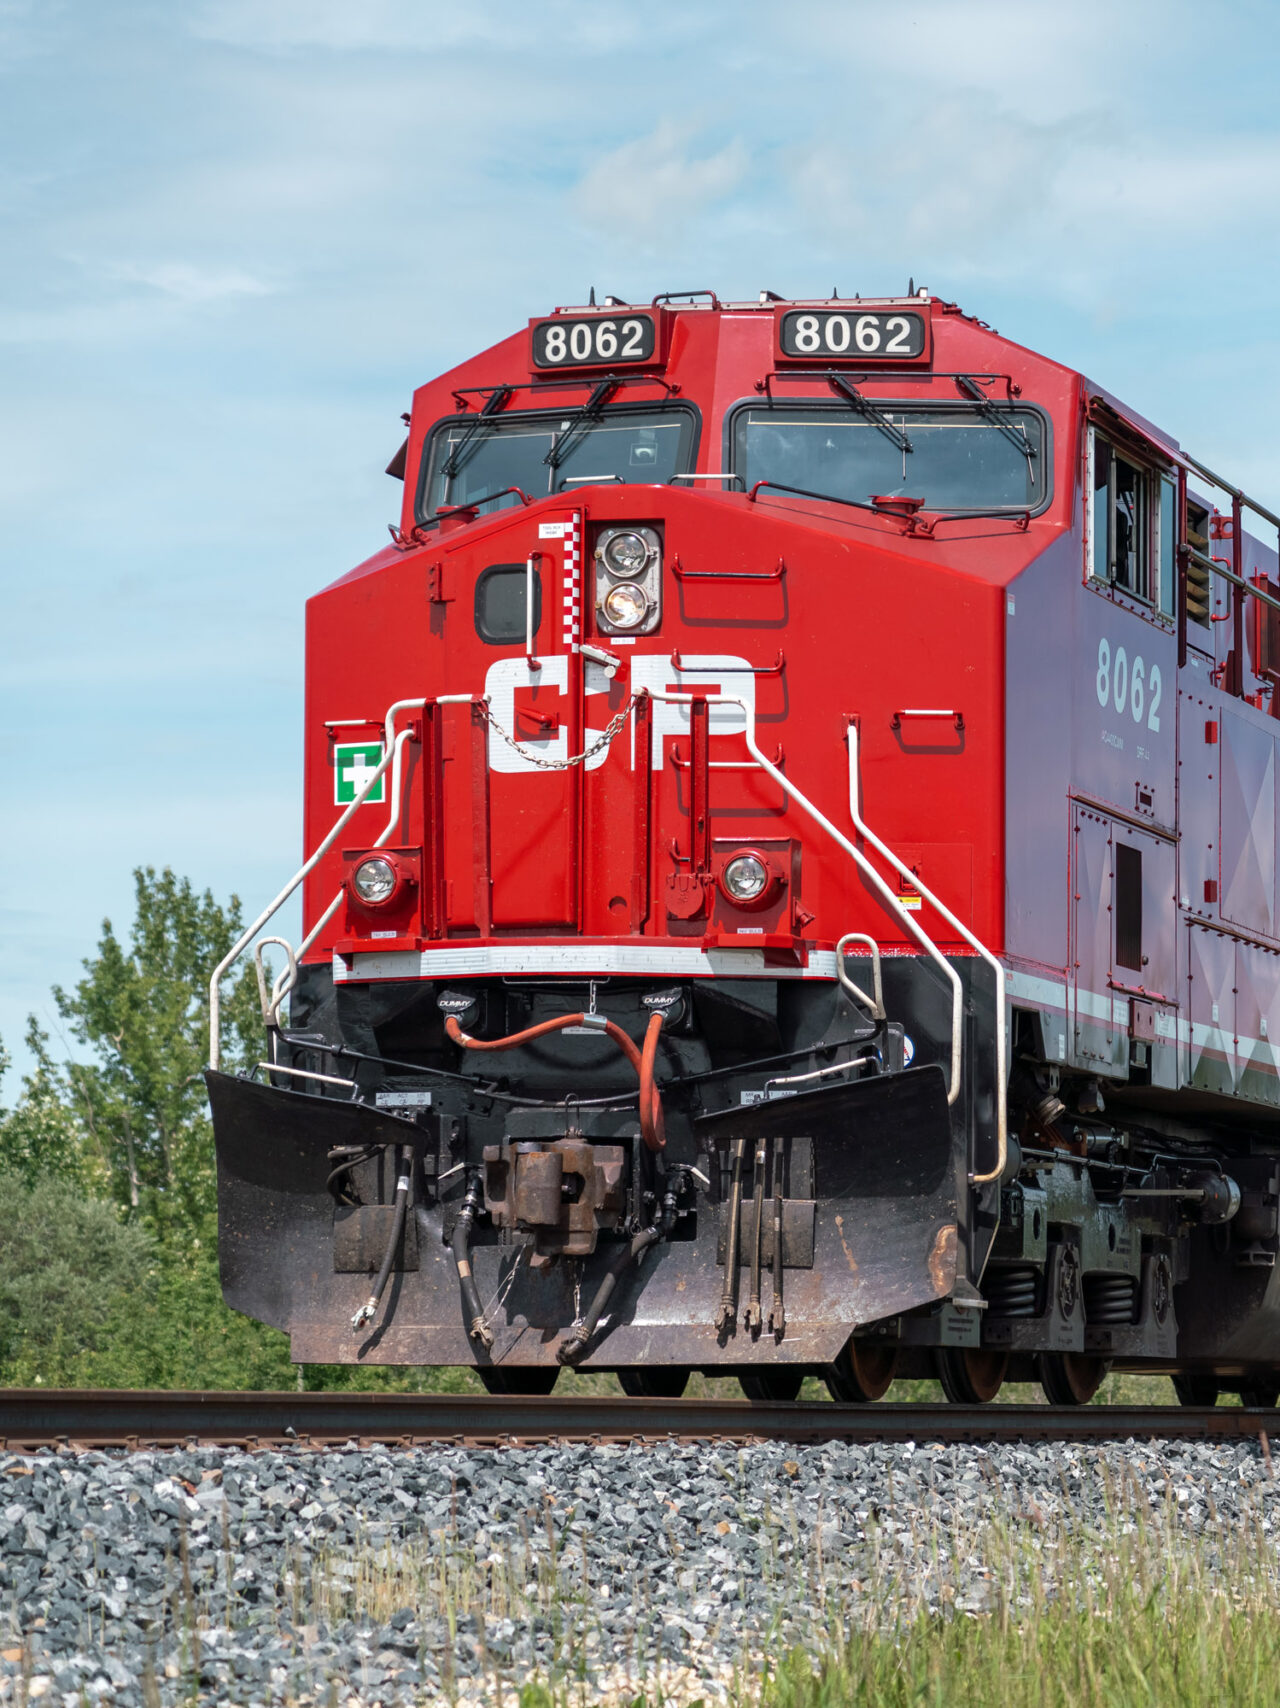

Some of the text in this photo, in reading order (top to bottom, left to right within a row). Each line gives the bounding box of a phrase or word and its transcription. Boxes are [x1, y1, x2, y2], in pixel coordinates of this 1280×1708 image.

[545, 320, 644, 362] 8062
[795, 315, 911, 353] 8062
[485, 654, 756, 773] CP
[1096, 637, 1162, 733] 8062
